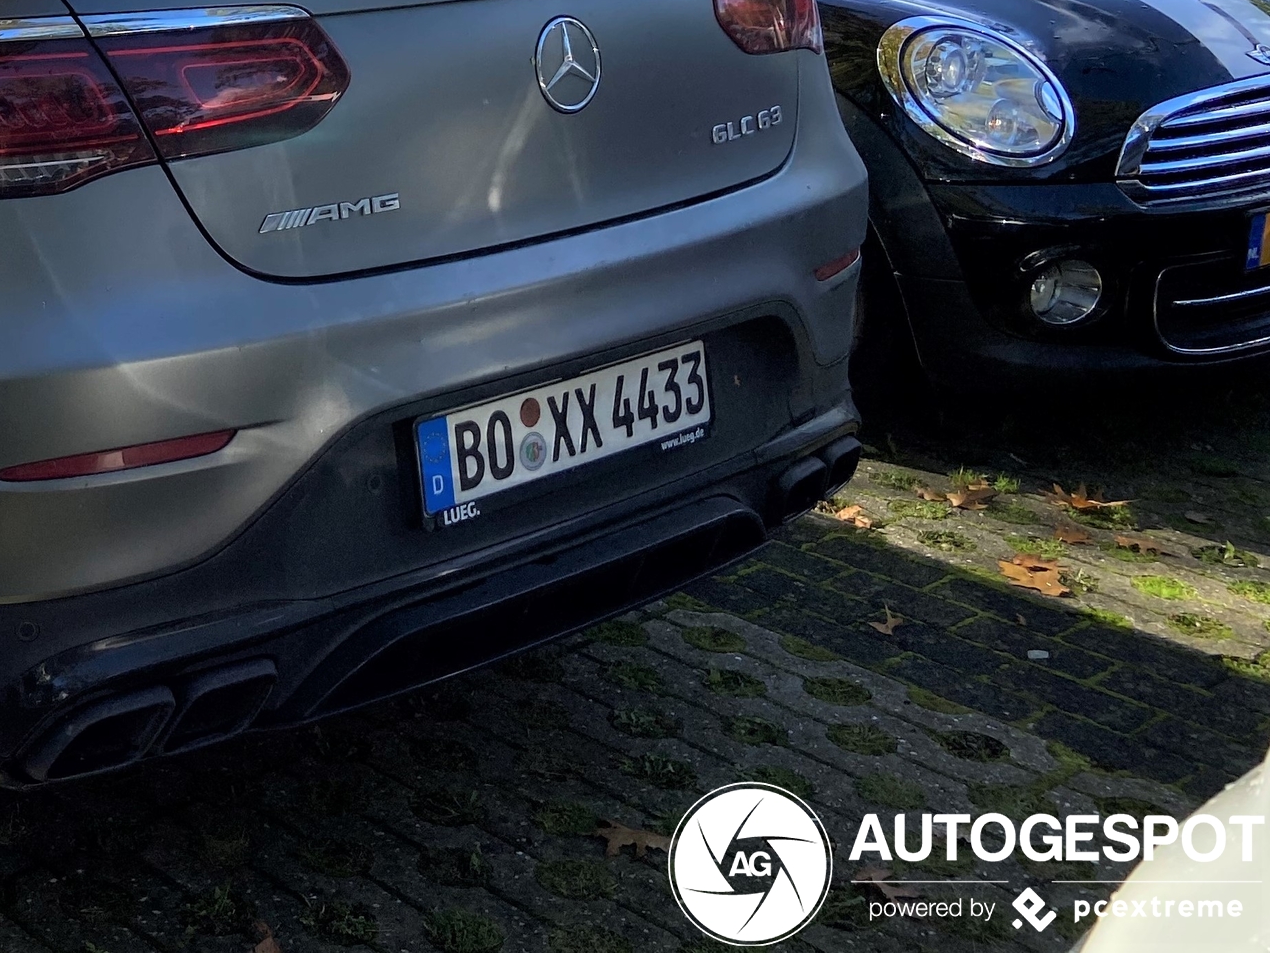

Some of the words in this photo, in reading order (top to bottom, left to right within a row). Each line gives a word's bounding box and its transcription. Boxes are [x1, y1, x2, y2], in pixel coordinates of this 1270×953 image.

[712, 114, 753, 145] GLC
[758, 105, 783, 130] 63
[306, 192, 400, 224] AMG
[455, 410, 514, 491] BO
[546, 382, 603, 462] XX
[612, 351, 706, 438] 4433
[660, 428, 705, 451] www.lueg.de
[432, 475, 444, 495] D
